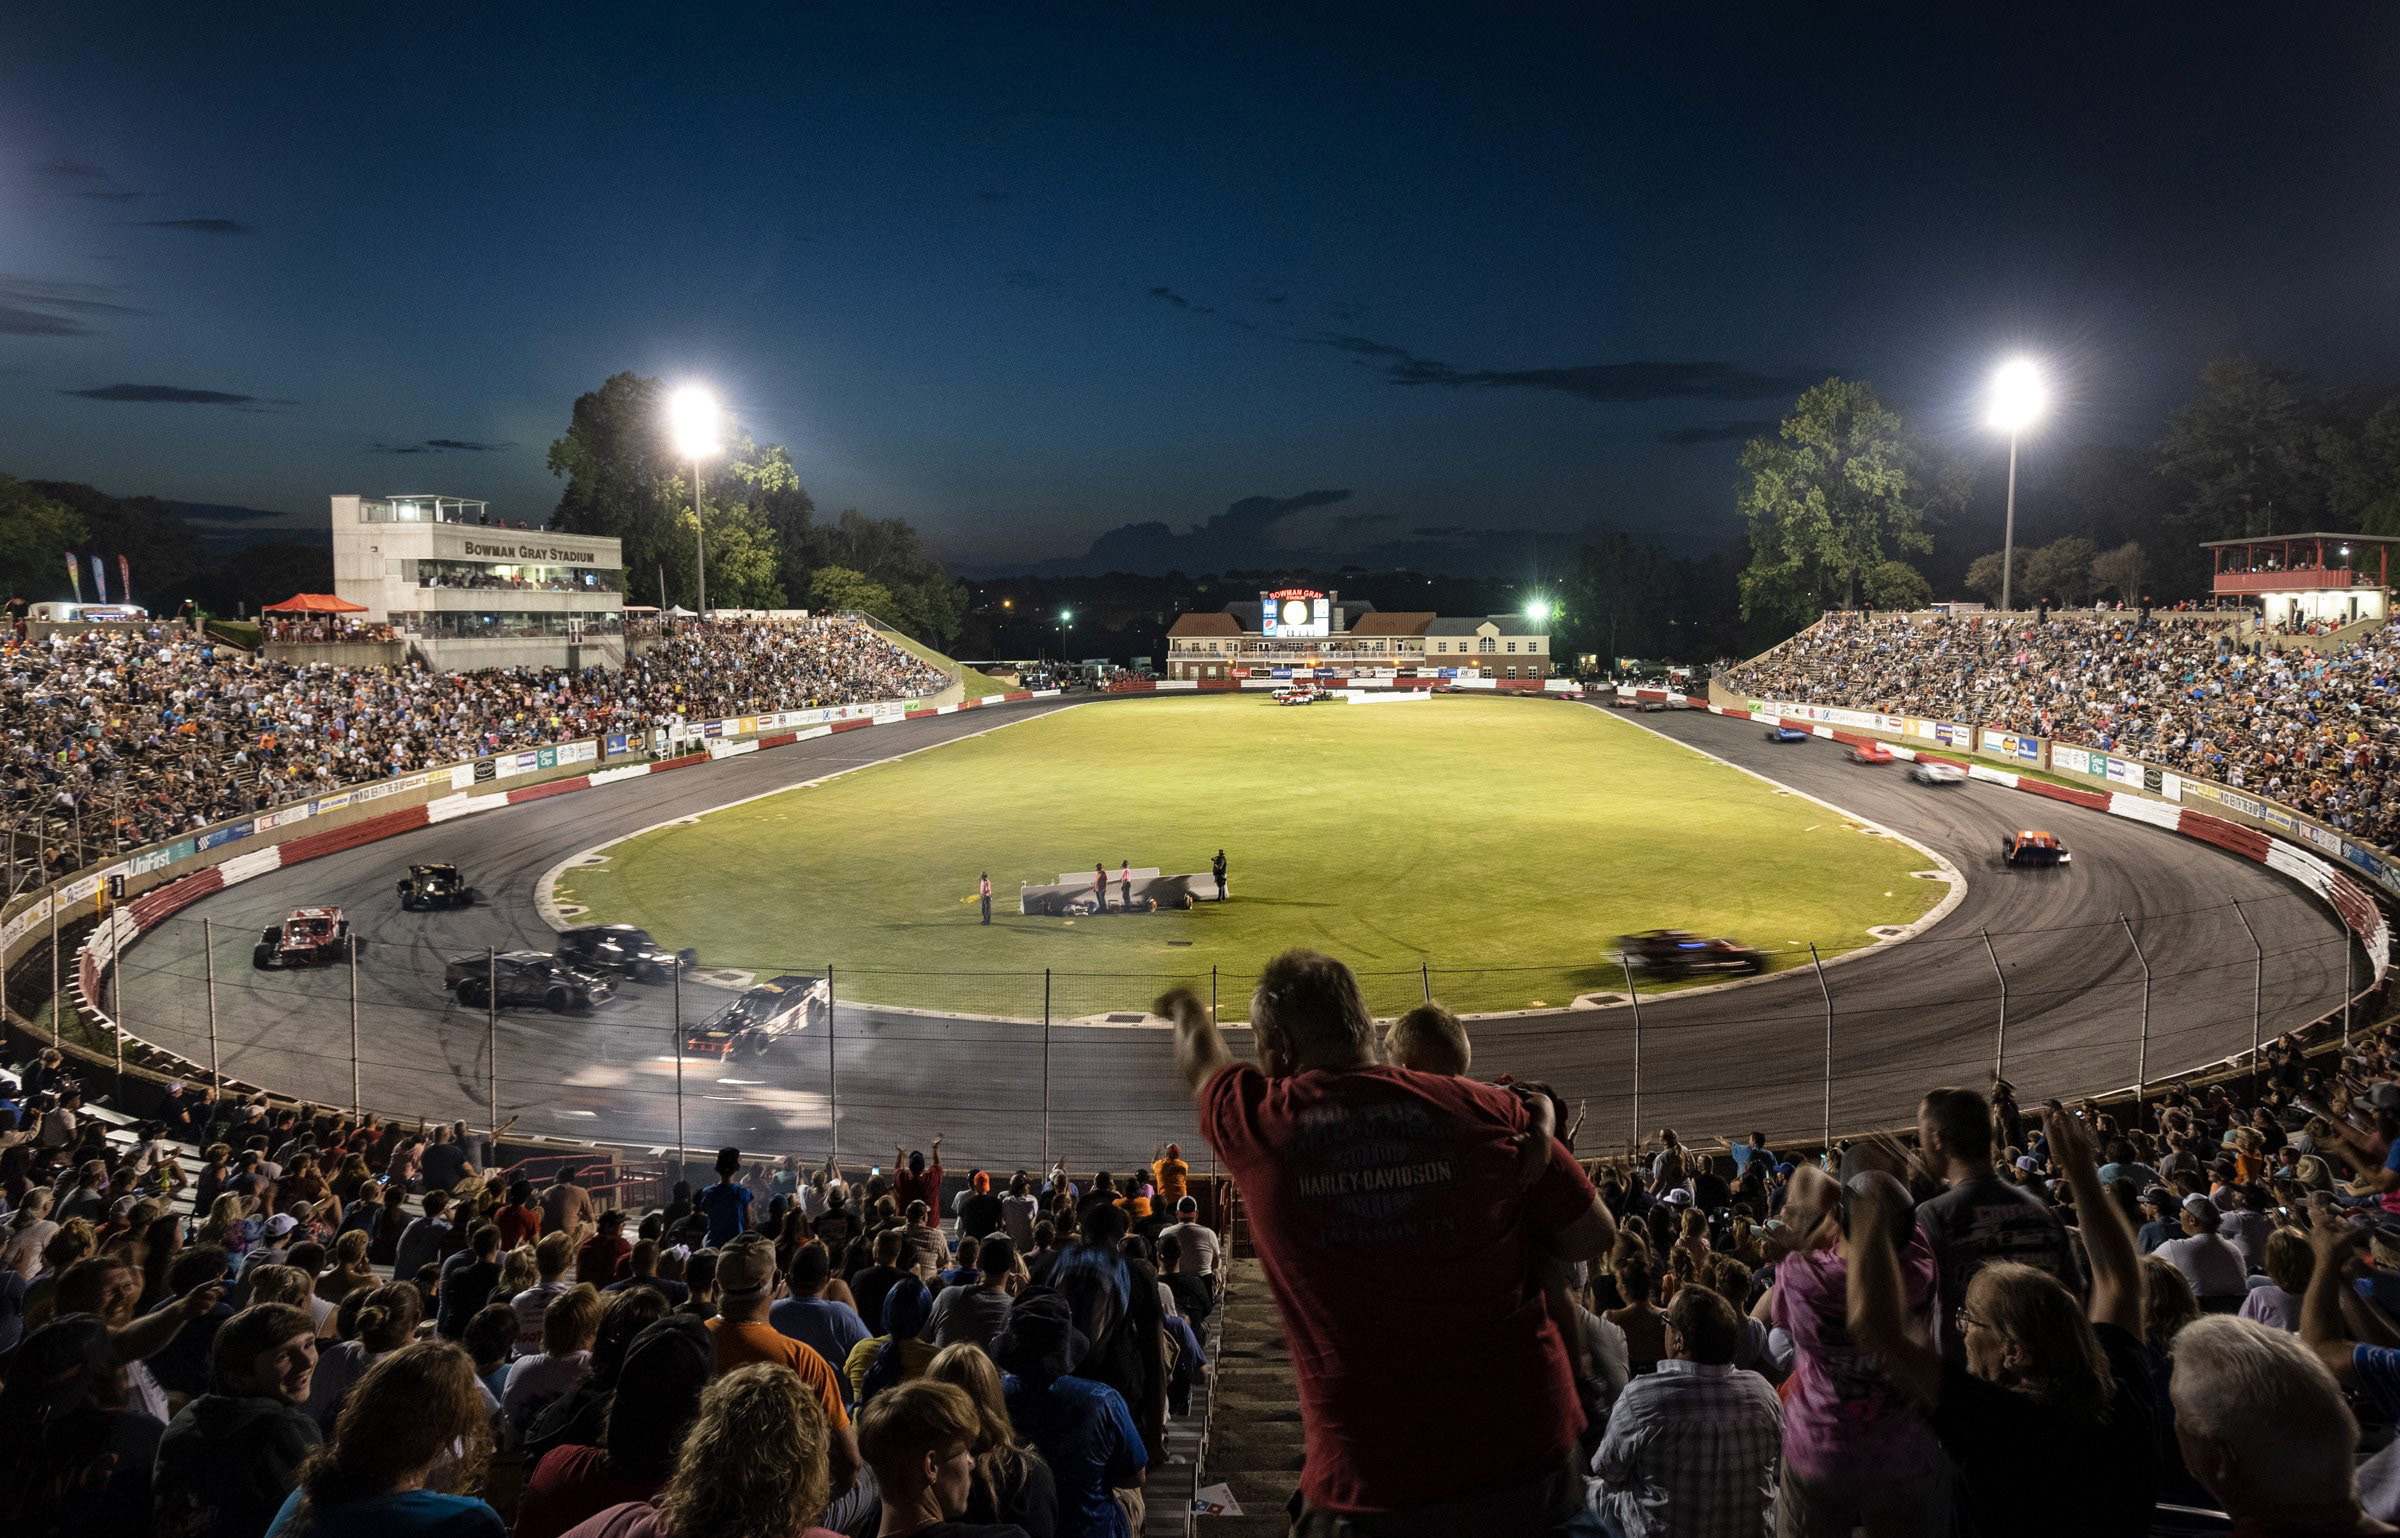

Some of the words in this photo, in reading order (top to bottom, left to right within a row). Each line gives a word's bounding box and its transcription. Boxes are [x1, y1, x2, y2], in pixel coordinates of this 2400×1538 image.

[465, 541, 515, 557] BOWMAN
[519, 546, 547, 559] GRAY
[550, 548, 595, 563] STADIUM
[1269, 589, 1302, 600] BOWMAN
[1303, 589, 1324, 600] GRAY
[130, 849, 171, 876] UniFirst
